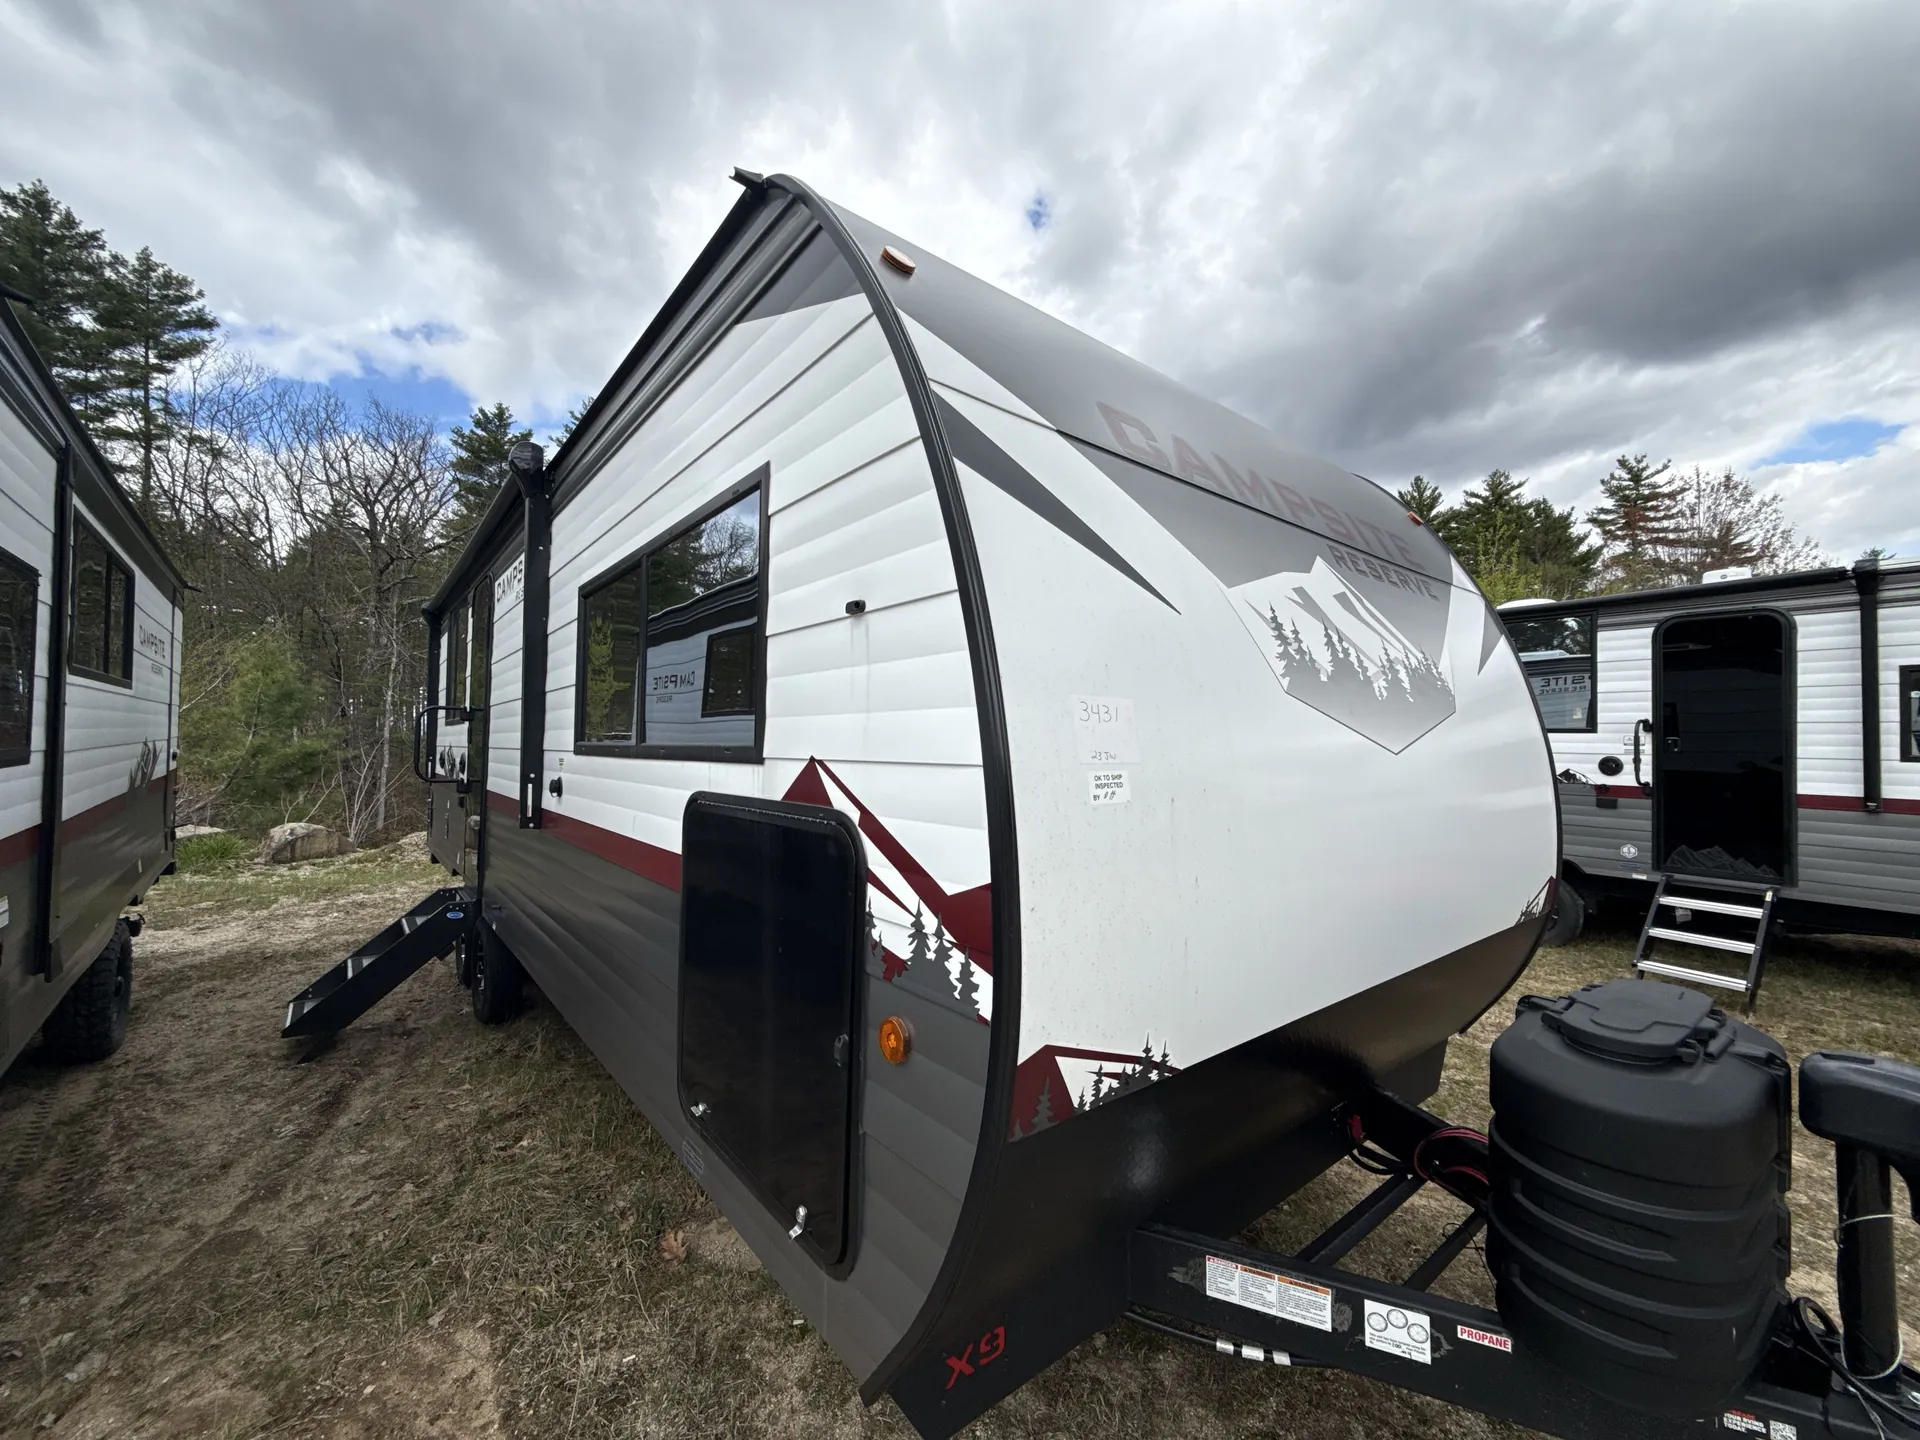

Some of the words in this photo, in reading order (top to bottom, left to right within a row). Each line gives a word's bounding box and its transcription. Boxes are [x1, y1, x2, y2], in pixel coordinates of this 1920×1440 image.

[1096, 400, 1427, 572] CAMPSITE
[1326, 543, 1439, 602] RESERVE
[1080, 701, 1118, 723] 3431
[1111, 773, 1122, 781] SHIP
[1460, 1327, 1510, 1350] PROPANE
[1723, 1417, 1767, 1434] EXPERIENCE
[1724, 1412, 1741, 1421] YOUR
